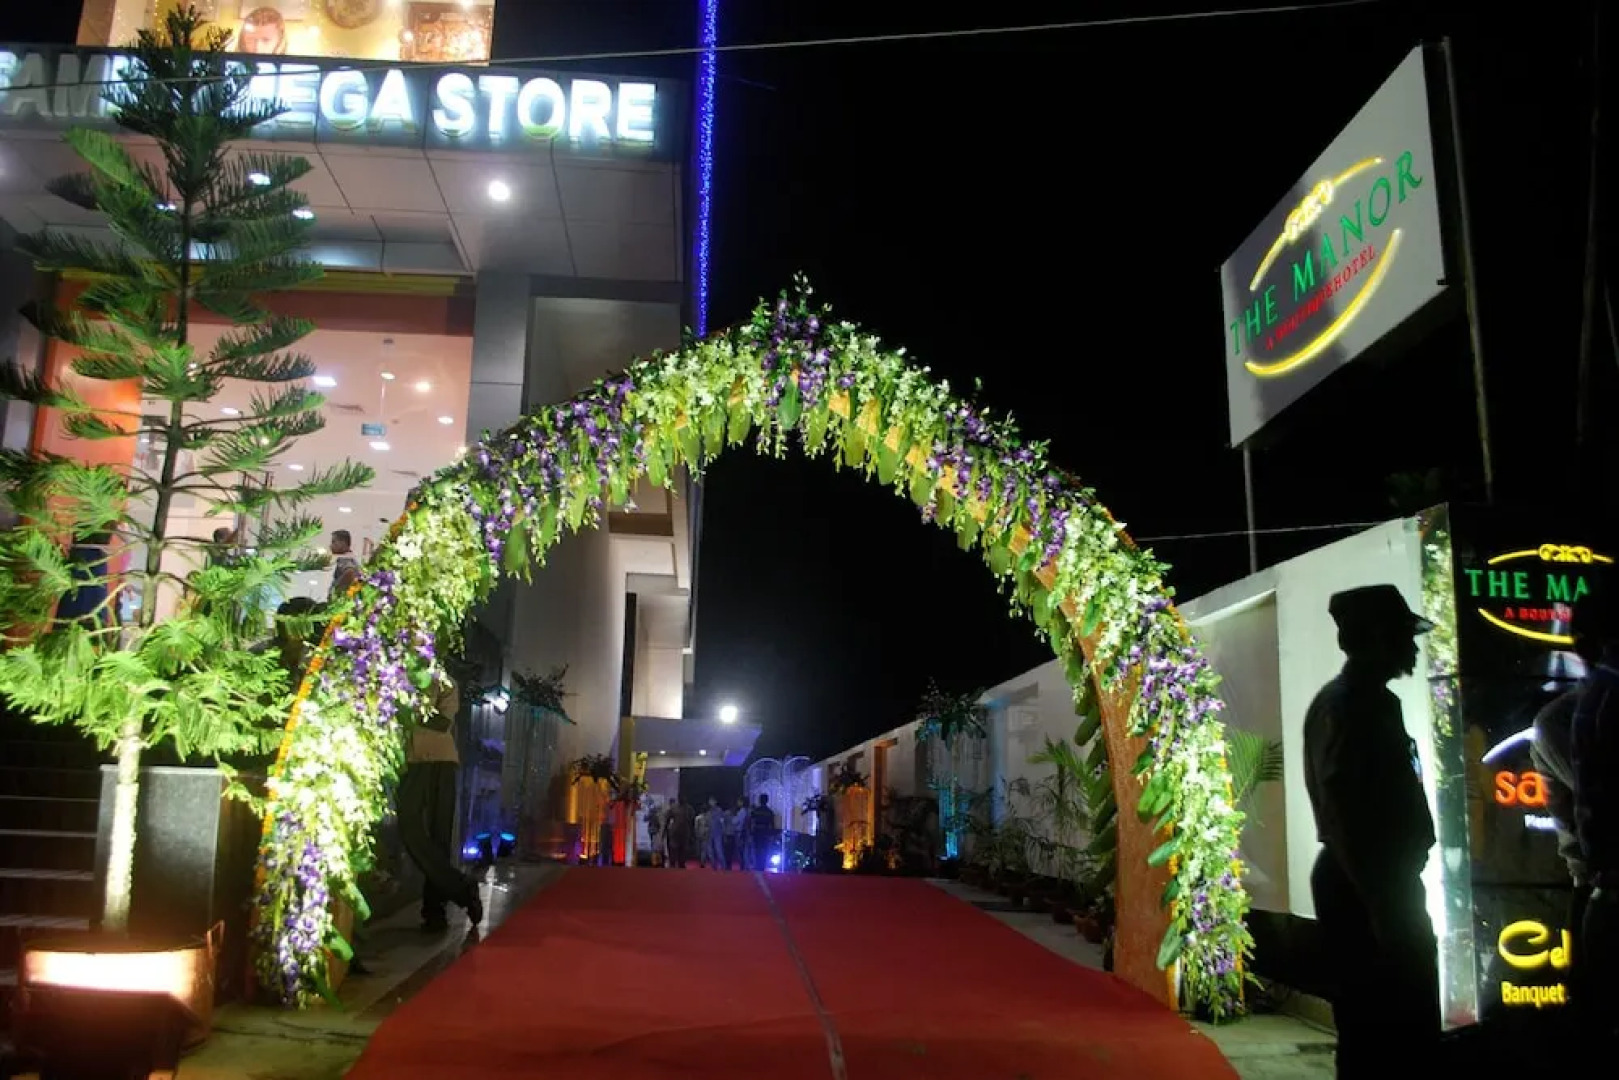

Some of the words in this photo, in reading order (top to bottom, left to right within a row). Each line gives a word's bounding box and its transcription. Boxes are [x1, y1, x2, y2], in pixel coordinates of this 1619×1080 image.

[432, 72, 657, 142] STORE
[1230, 284, 1277, 355] THE
[1292, 151, 1422, 302] MANOR
[1333, 244, 1375, 292] HOTEL
[1465, 569, 1530, 599] THE
[1505, 606, 1515, 620] A
[1501, 981, 1566, 1009] Banquet
